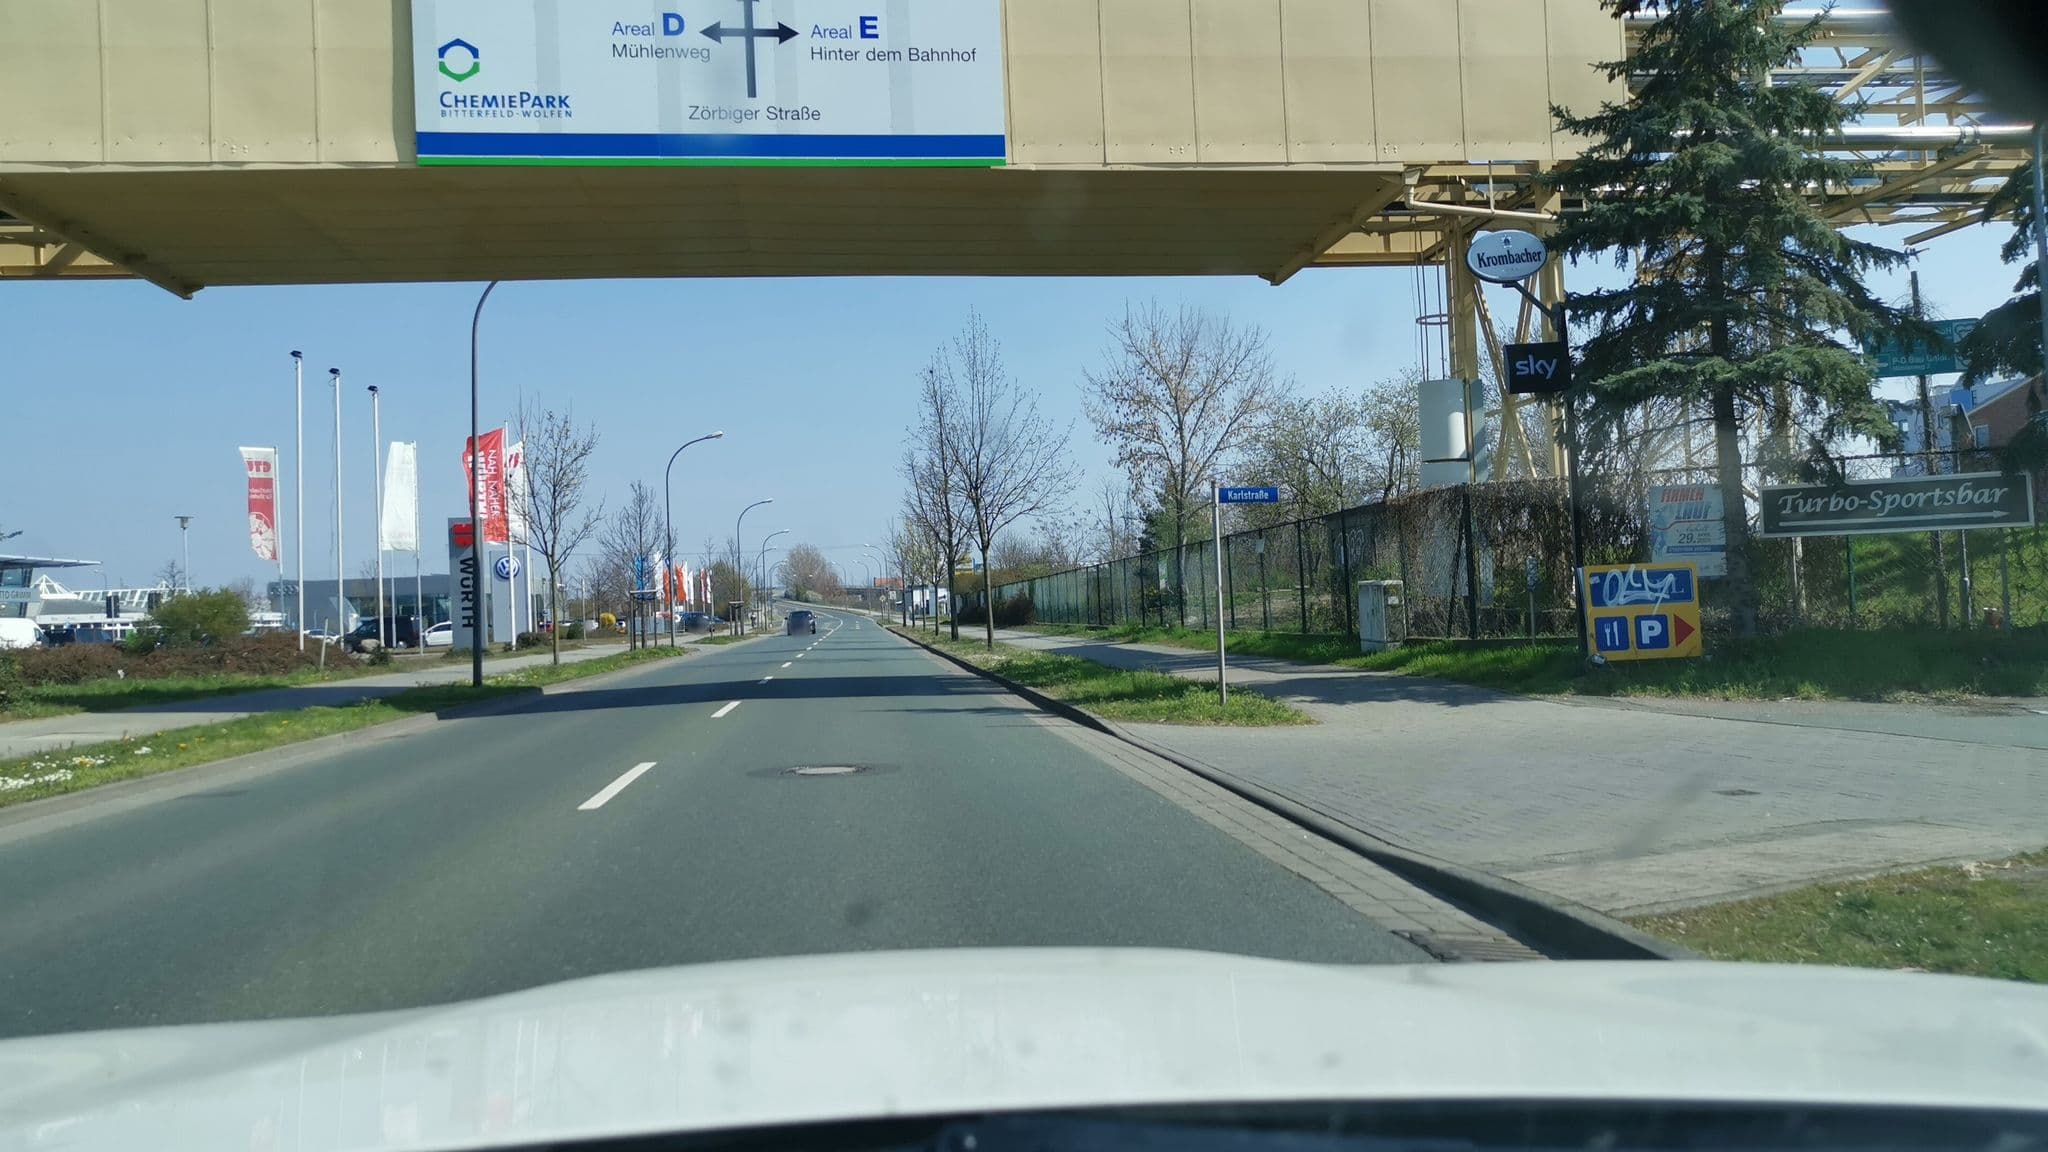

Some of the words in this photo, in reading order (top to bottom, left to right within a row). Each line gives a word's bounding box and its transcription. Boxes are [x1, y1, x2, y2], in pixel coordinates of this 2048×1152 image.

[612, 21, 655, 36] Areal
[662, 12, 686, 36] D
[810, 24, 853, 39] Areal
[859, 15, 879, 39] E
[612, 44, 711, 62] Mühlenweg
[810, 46, 861, 62] Hinter
[865, 47, 902, 62] dem
[908, 47, 976, 62] Bahnhof
[440, 110, 573, 118] BITTERFELD-WOLFEN
[688, 105, 760, 123] Zörbiger
[766, 105, 821, 120] Straße
[1476, 248, 1542, 268] Krombacher
[1515, 354, 1557, 379] sky
[1227, 489, 1270, 501] Karlstraße
[1777, 482, 2009, 518] Turbo-Sportsbar
